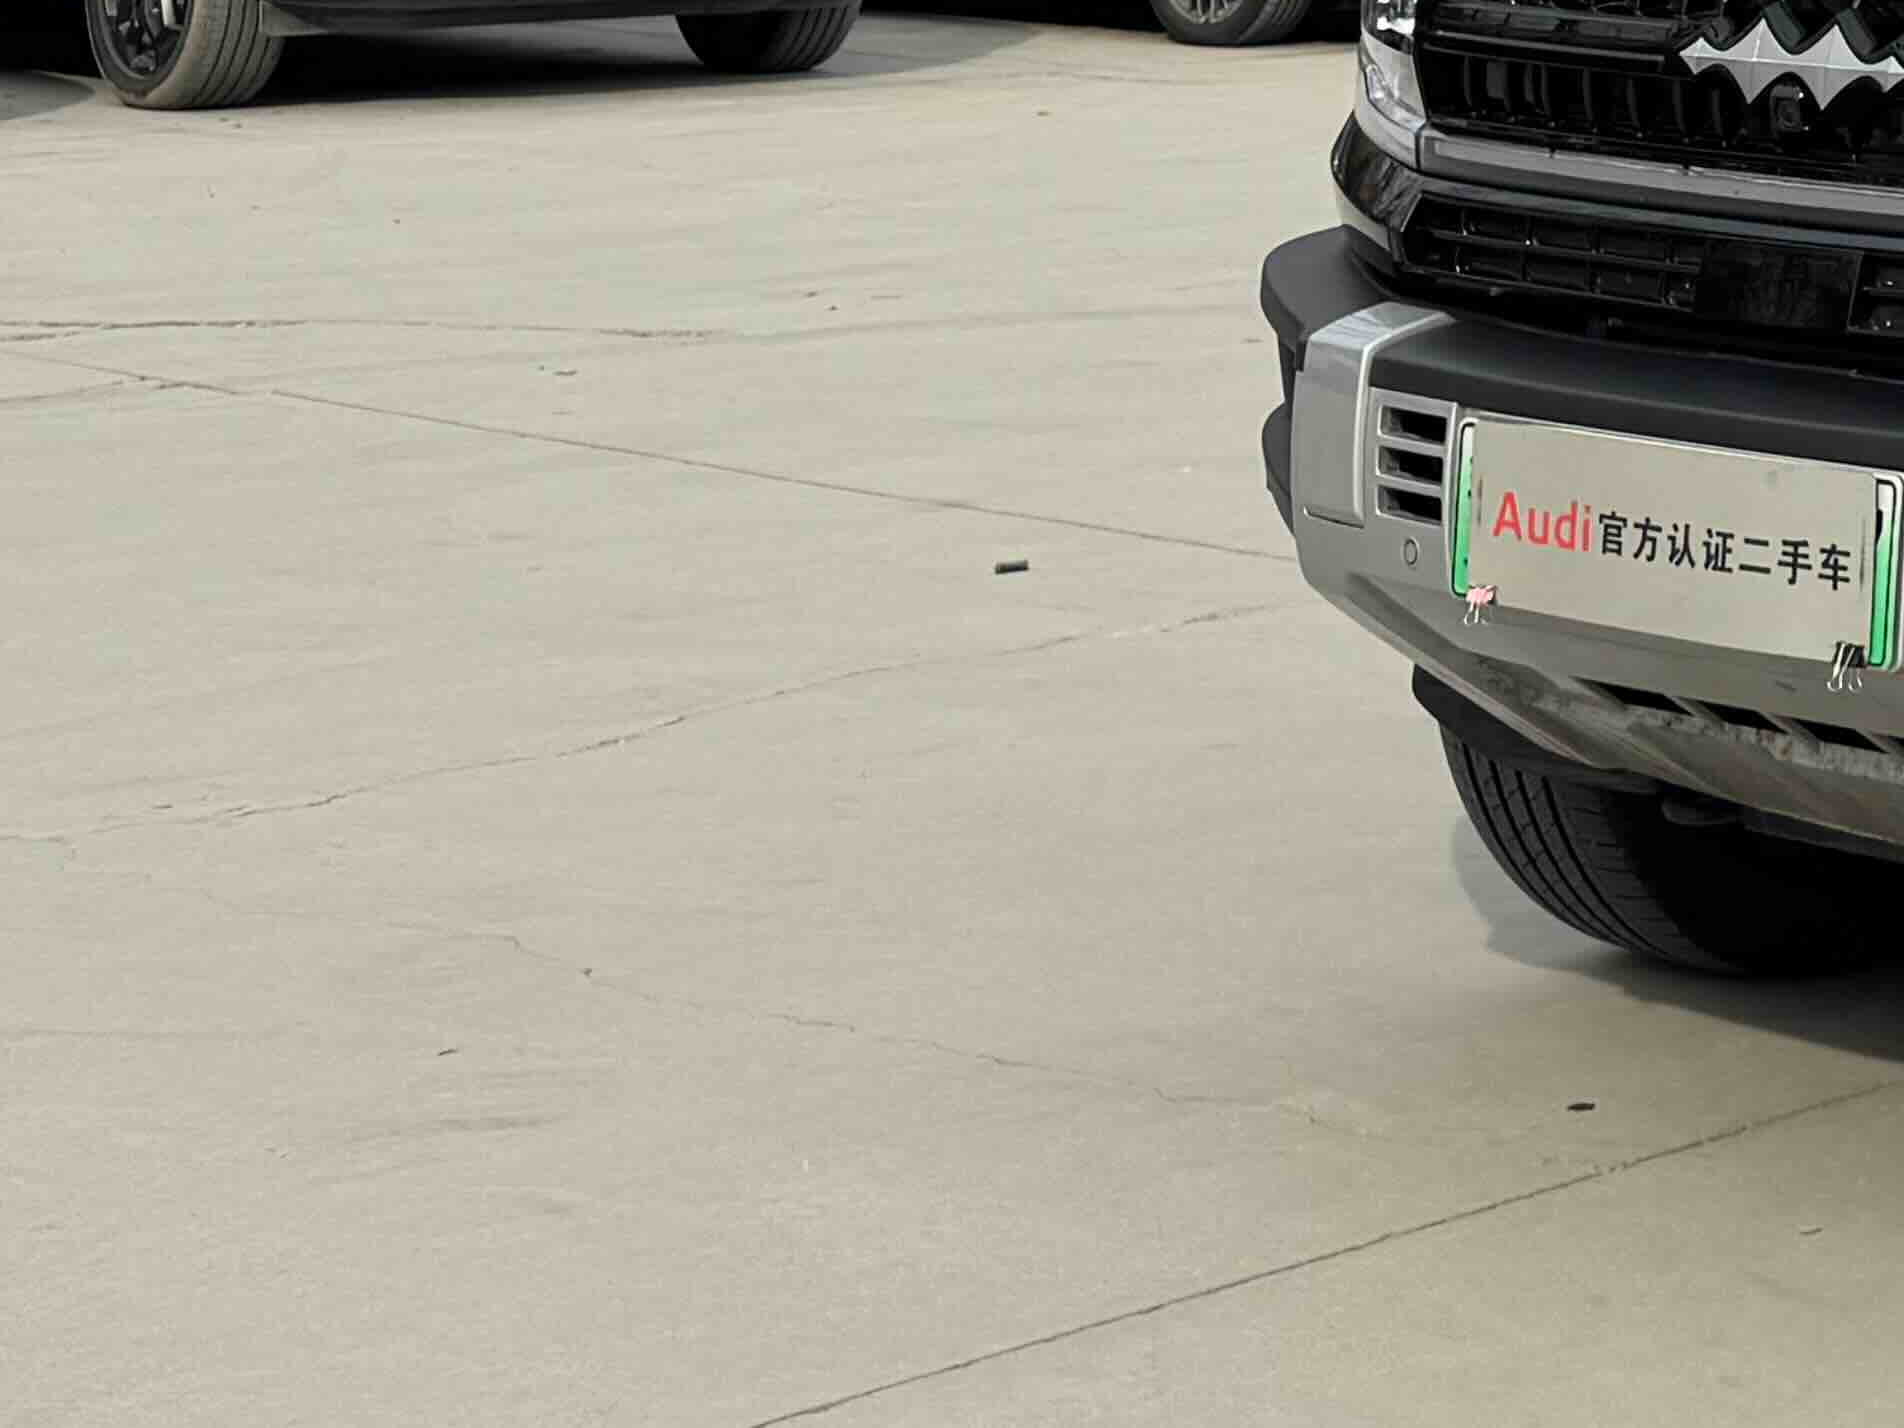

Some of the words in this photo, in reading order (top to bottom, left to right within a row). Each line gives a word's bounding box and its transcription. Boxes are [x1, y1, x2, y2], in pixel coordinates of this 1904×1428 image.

[1493, 491, 1592, 553] Audi
[1600, 511, 1850, 591] 官方认证二手车
